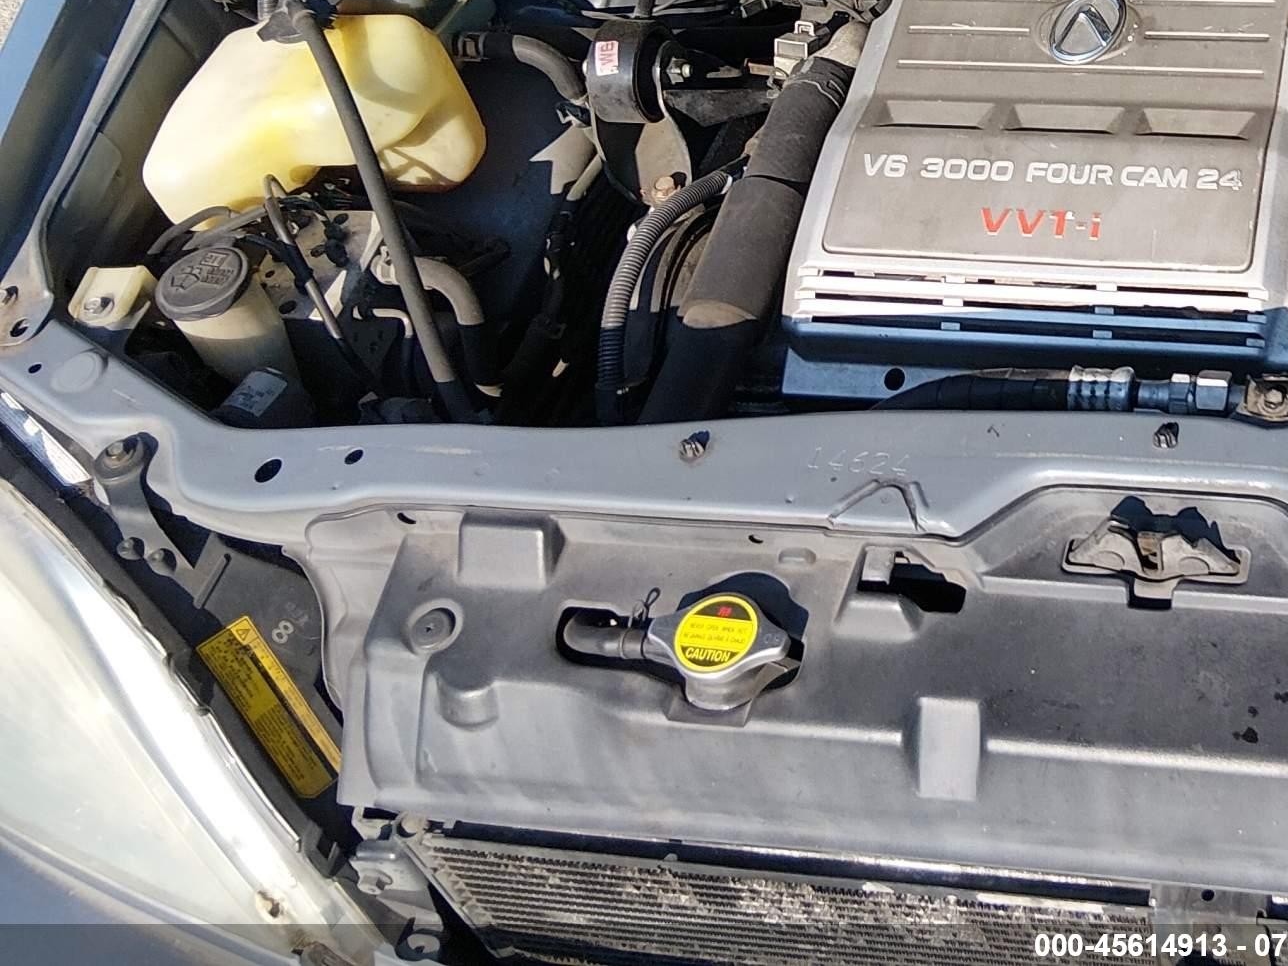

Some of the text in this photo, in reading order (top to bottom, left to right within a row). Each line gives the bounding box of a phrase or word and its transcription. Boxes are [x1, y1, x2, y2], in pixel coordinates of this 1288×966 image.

[864, 153, 1243, 190] V6 3000 FOUR CAM 24
[807, 446, 911, 476] 14624
[271, 620, 294, 644] 8
[685, 647, 731, 662] CAUTION
